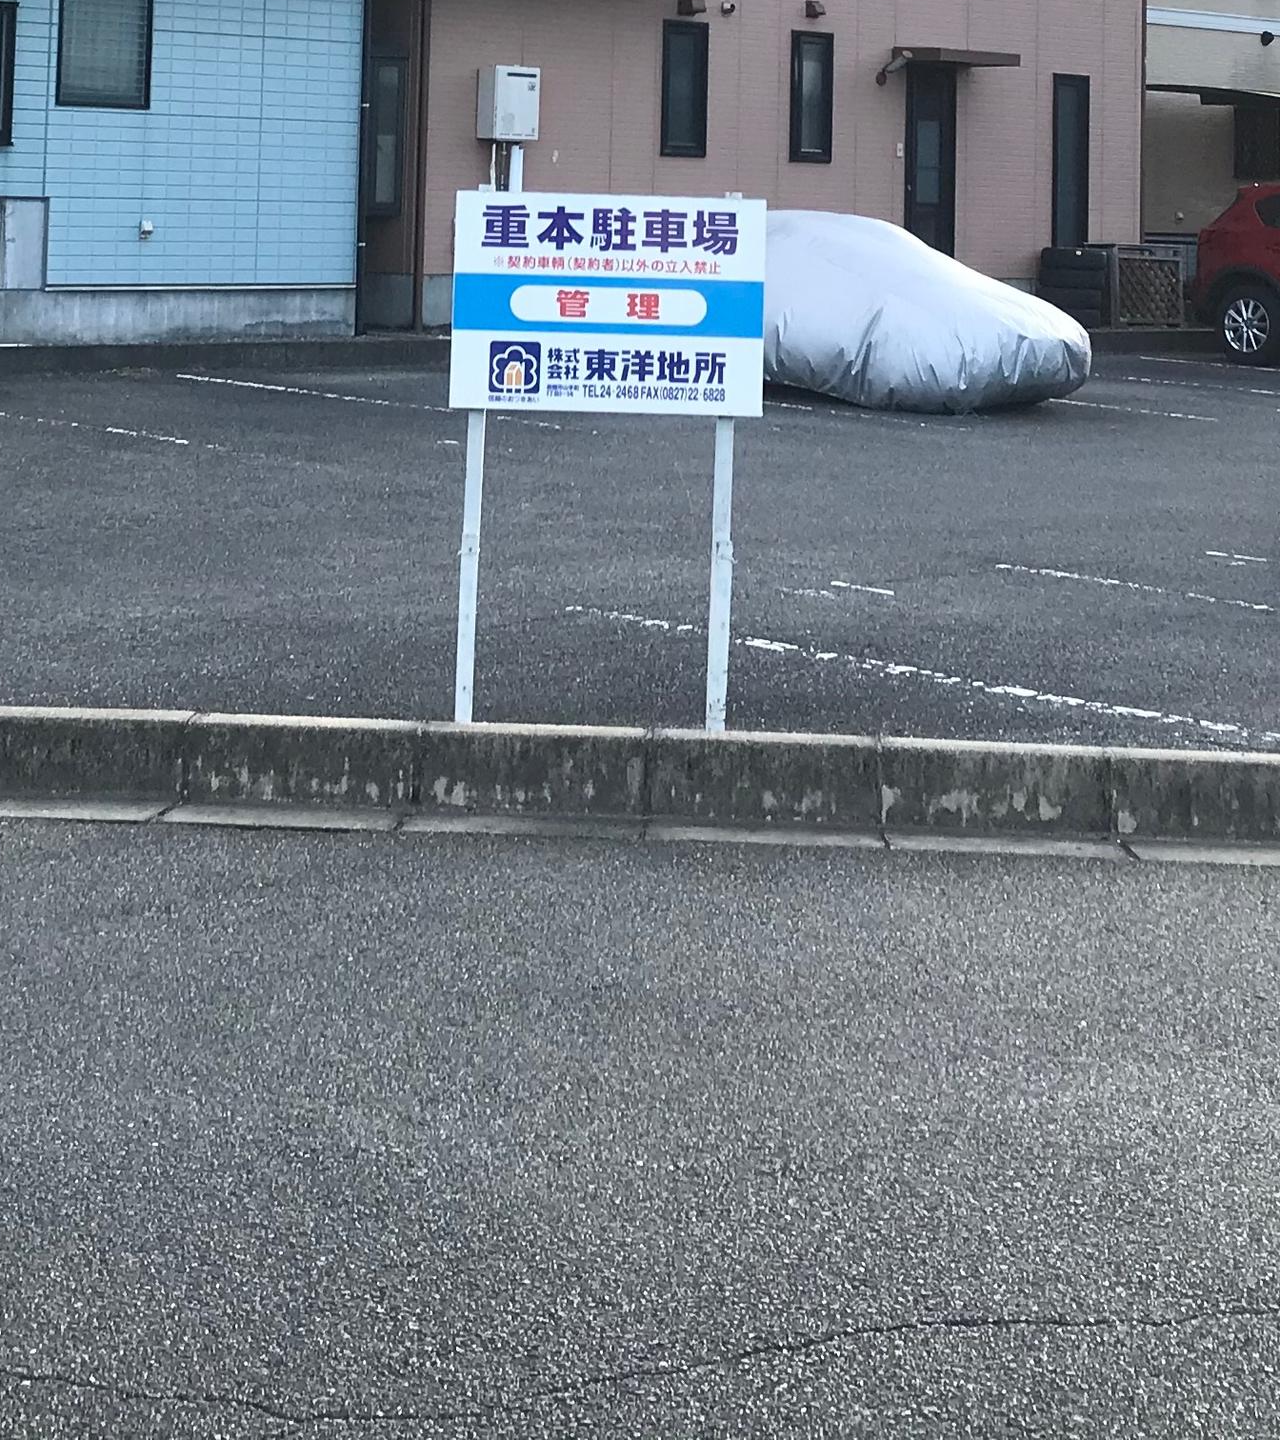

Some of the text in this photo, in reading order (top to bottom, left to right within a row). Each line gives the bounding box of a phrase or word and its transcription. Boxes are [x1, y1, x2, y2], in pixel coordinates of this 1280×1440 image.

[481, 204, 739, 255] 重本駐車場
[583, 348, 727, 385] 東洋地所
